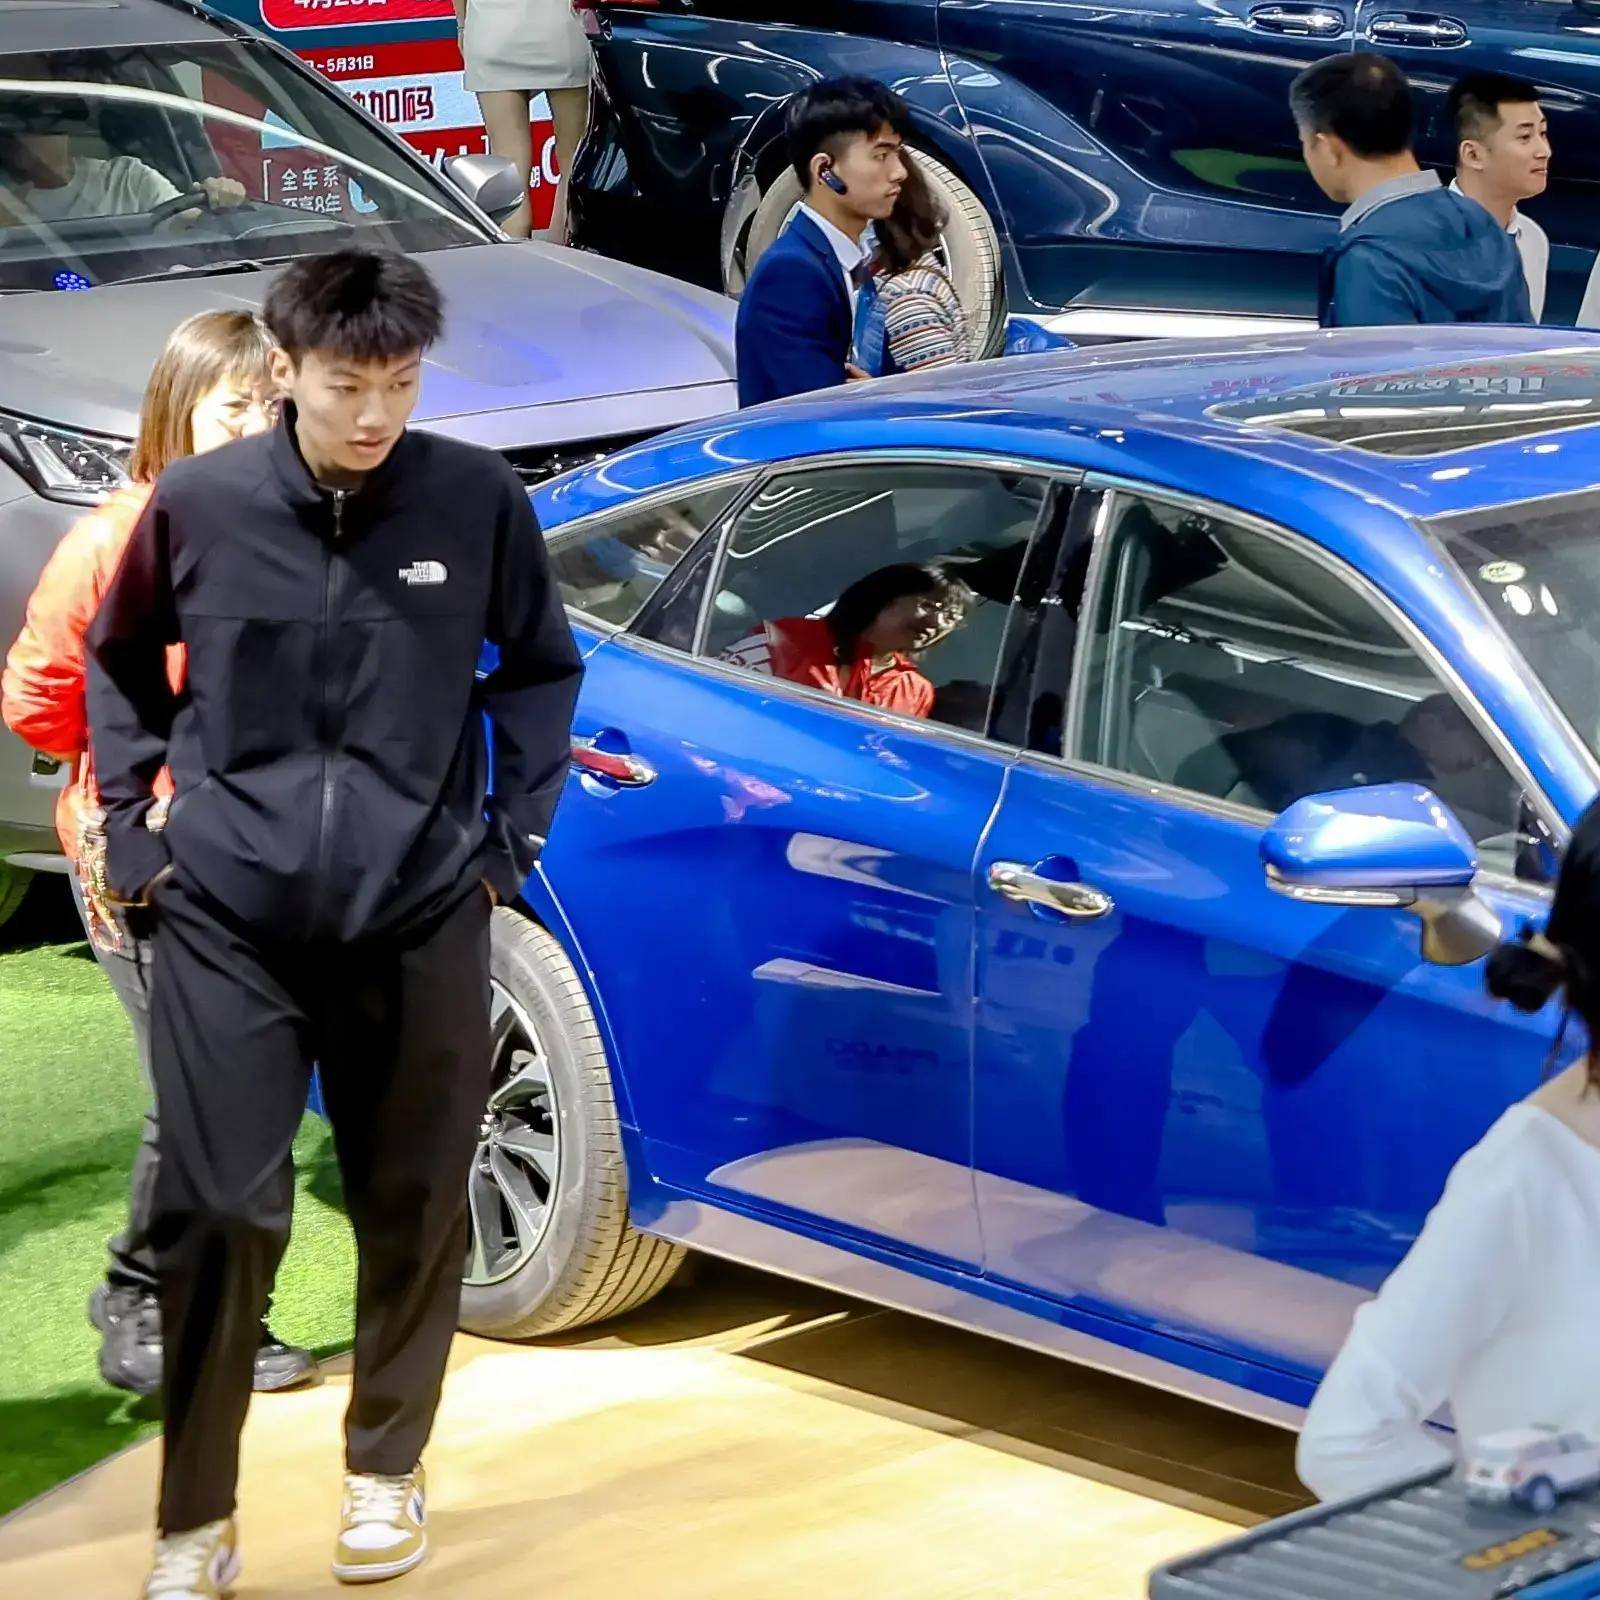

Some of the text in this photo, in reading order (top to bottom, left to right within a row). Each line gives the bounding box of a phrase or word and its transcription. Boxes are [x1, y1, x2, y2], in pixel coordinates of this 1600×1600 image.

[349, 85, 435, 124] 加码
[280, 165, 340, 193] 全车系
